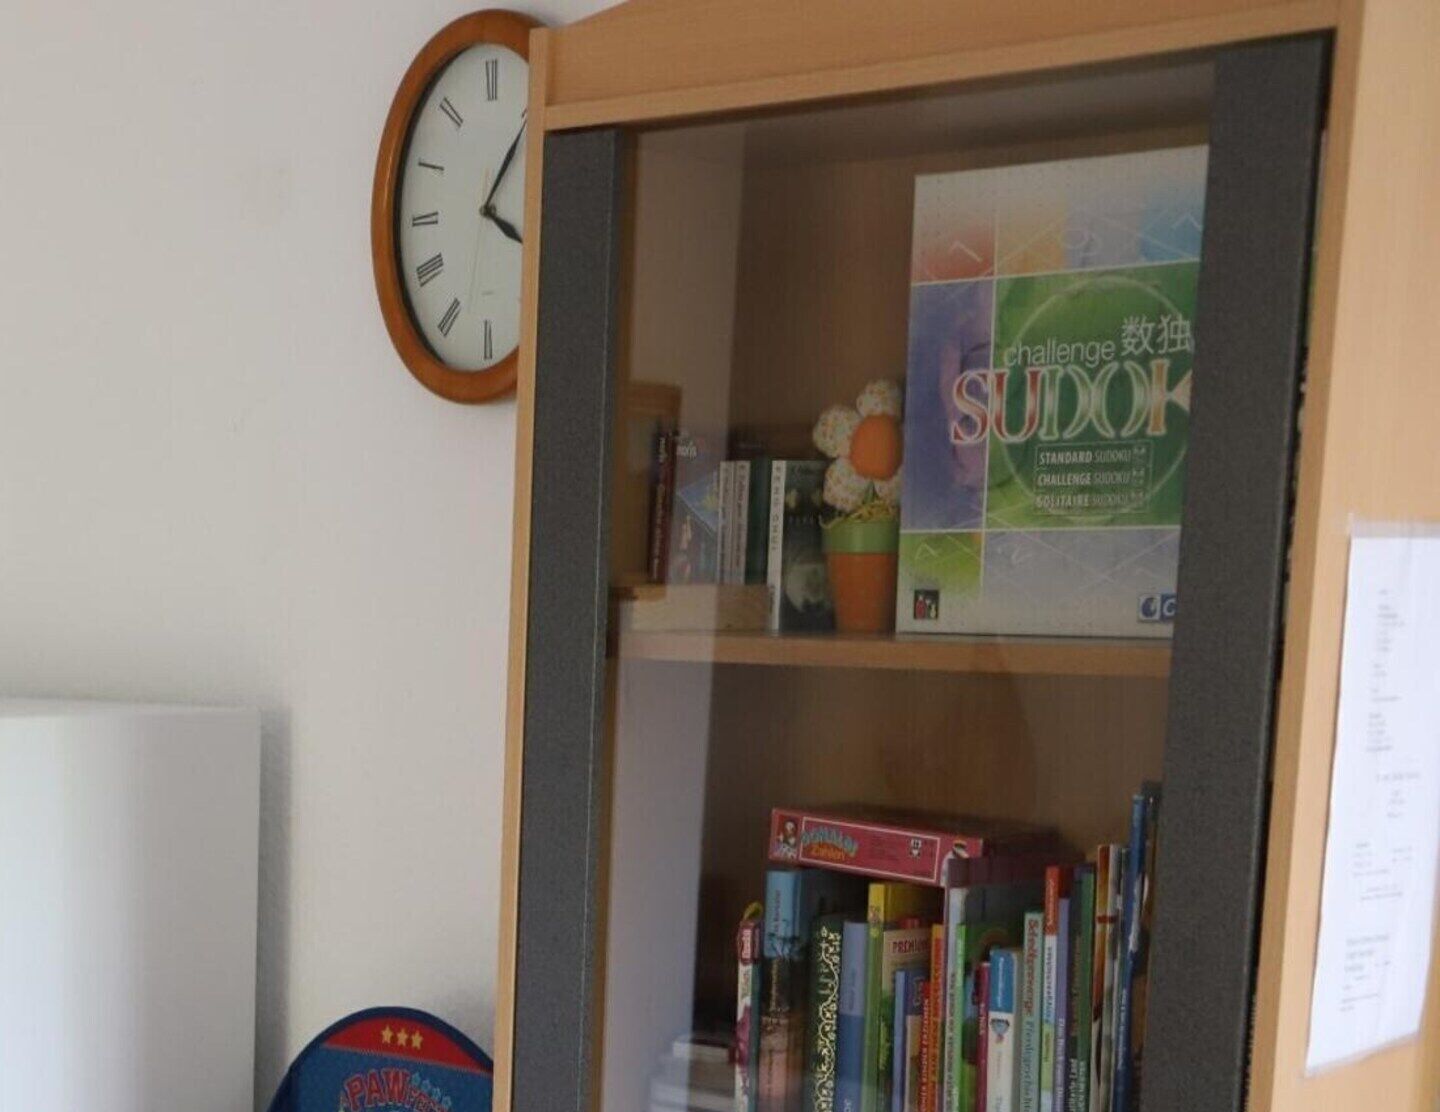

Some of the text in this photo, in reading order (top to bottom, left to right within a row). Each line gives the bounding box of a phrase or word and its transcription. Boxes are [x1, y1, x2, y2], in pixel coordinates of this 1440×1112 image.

[1121, 314, 1194, 356] 数独
[1003, 338, 1116, 369] challenge
[1040, 450, 1093, 465] STANDARD
[1038, 471, 1091, 486] CHALLENGE
